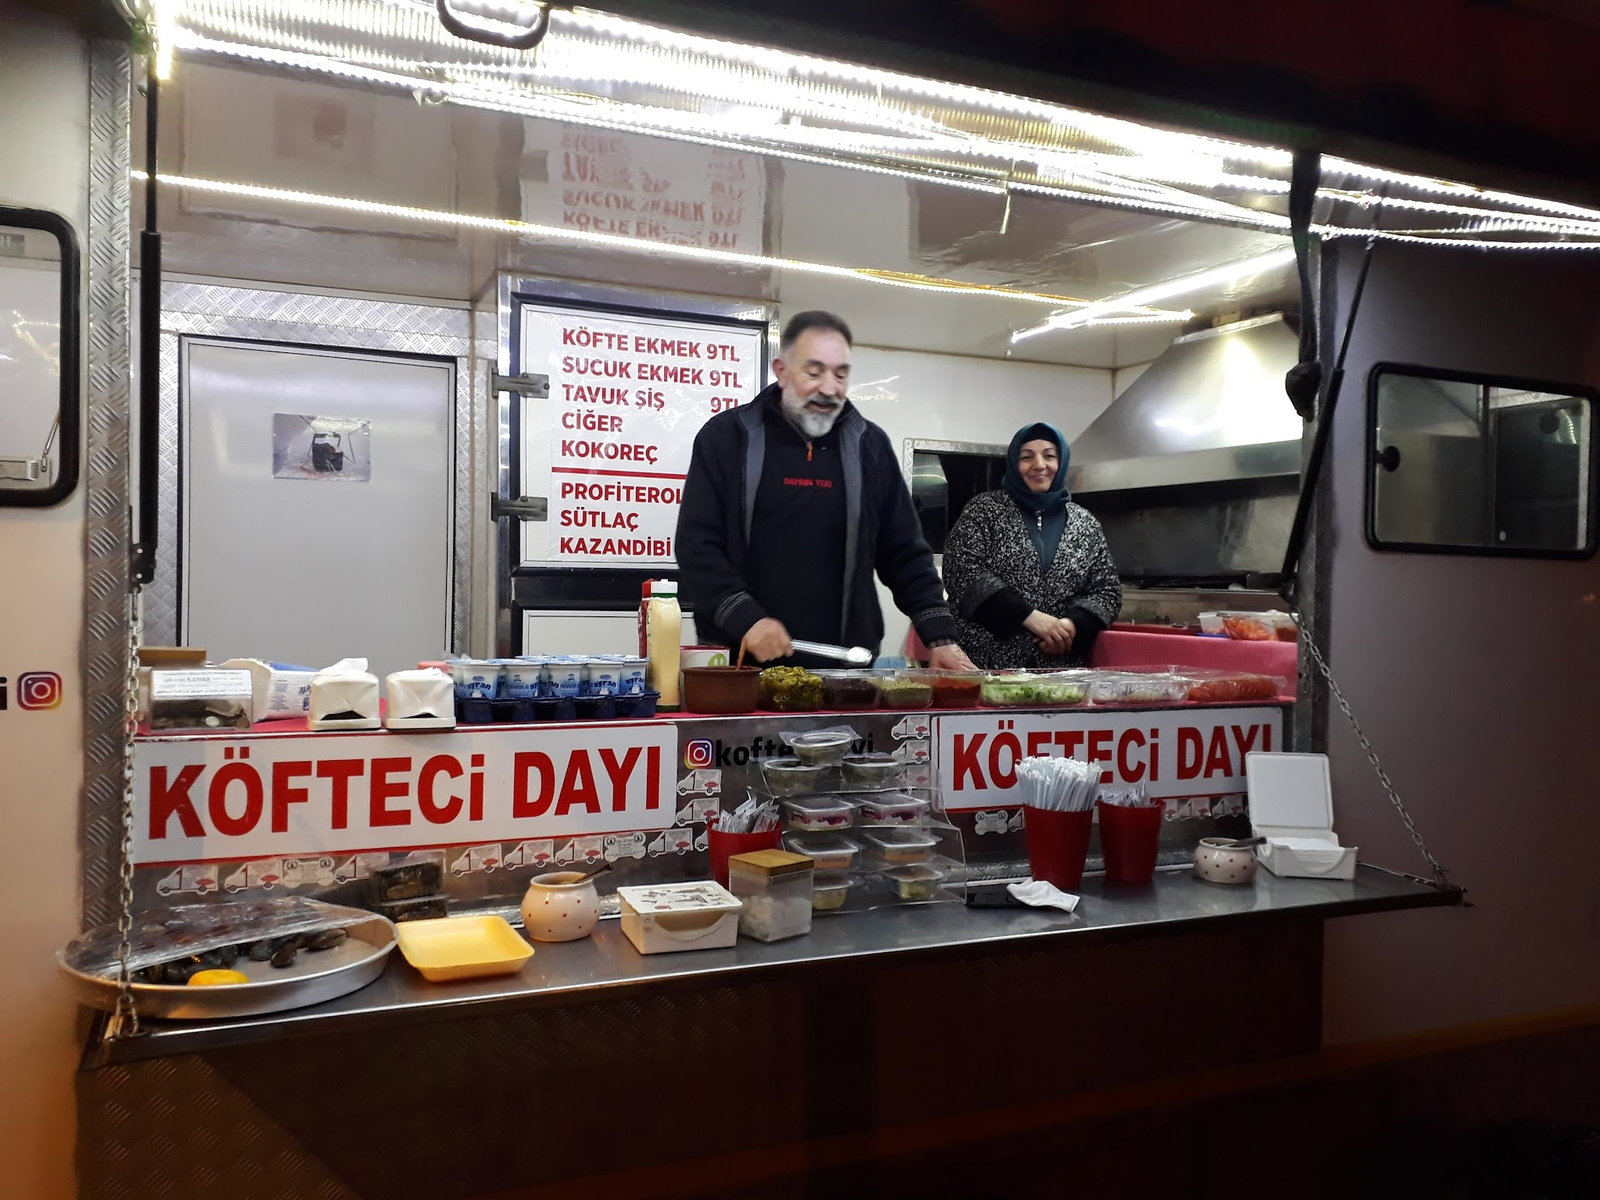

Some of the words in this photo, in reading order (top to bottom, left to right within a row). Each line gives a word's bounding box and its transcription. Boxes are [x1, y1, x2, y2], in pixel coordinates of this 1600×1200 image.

[562, 326, 629, 352] KÖFTE
[634, 336, 701, 359] EKMEK
[706, 343, 740, 363] 9TL
[562, 355, 632, 379] SUCUK
[637, 364, 704, 385] EKMEK
[709, 370, 743, 389] 9TL
[562, 384, 630, 406] TAVUK
[635, 387, 665, 411] ŞİŞ
[561, 408, 624, 432] CİĞER
[561, 439, 659, 465] KOKOREÇ
[560, 480, 683, 505] PROFİTEROL
[560, 506, 640, 532] SÜTLAÇ
[560, 536, 672, 557] KAZANDİBİ
[512, 746, 662, 821] DAYI
